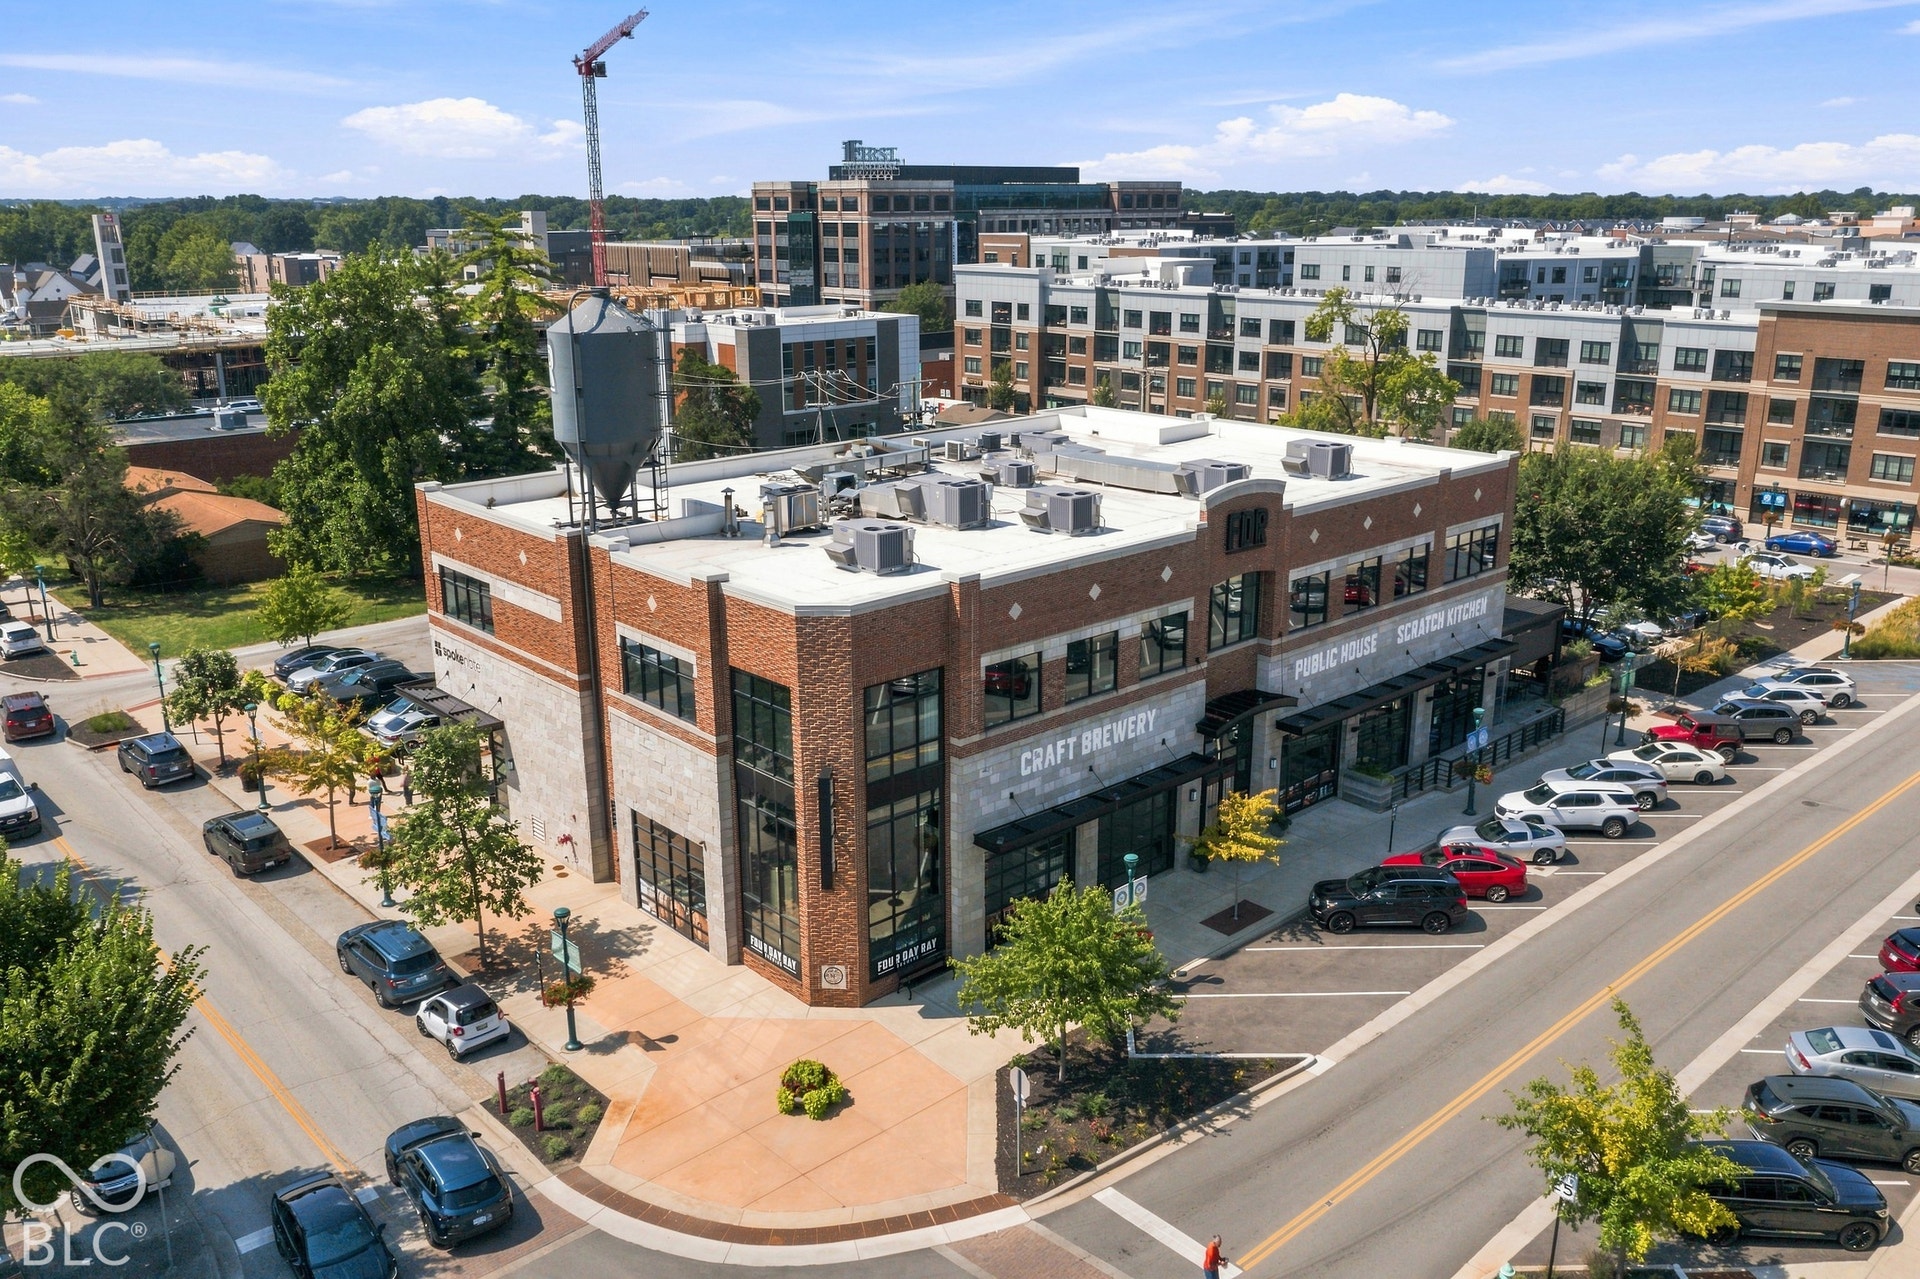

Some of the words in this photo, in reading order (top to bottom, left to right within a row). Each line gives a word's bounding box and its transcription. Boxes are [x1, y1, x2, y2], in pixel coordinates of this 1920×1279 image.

[1226, 509, 1268, 553] FDR
[1397, 611, 1445, 644] SCRATCH
[1446, 596, 1488, 626] KITCHEN
[1295, 647, 1338, 680] PUBLIC
[1340, 632, 1378, 664] HOUSE
[1020, 736, 1077, 776] CRAFT
[1081, 708, 1156, 756] BREWERY
[768, 945, 781, 961] DAY
[877, 953, 900, 972] FOUR
[902, 945, 919, 961] DAY
[920, 937, 937, 954] RAY
